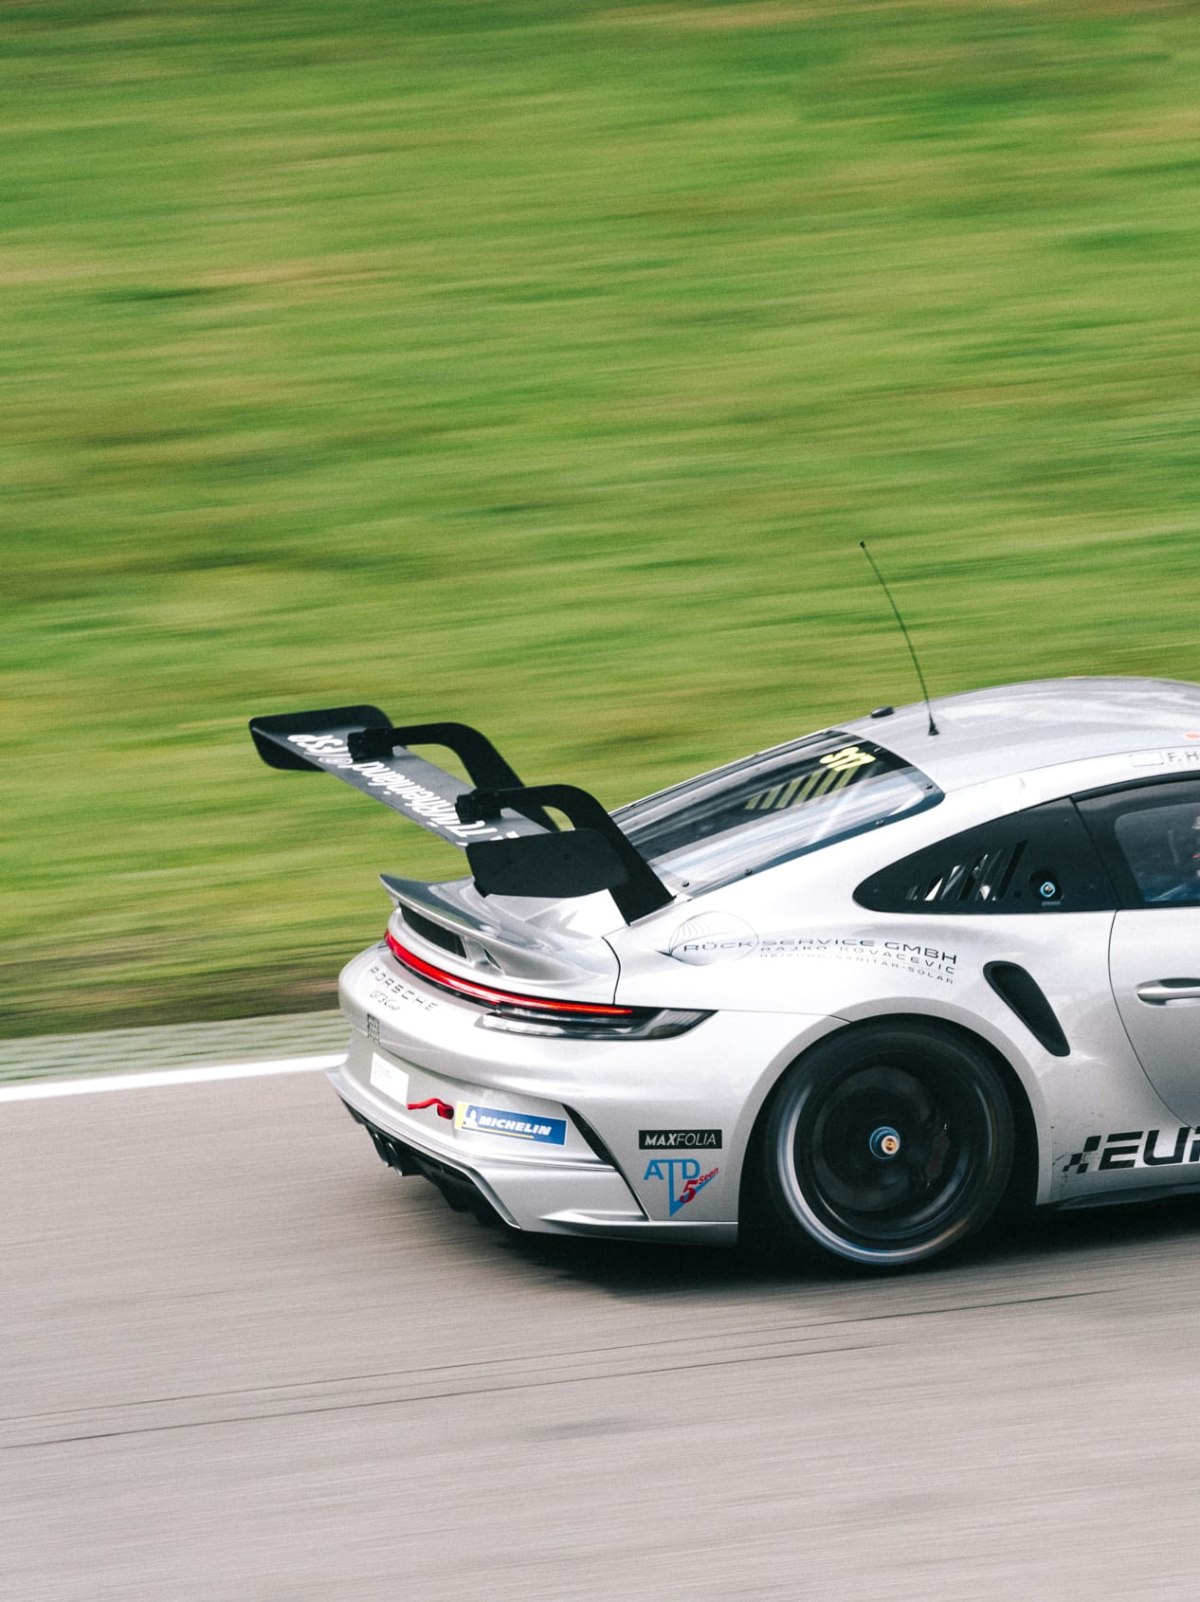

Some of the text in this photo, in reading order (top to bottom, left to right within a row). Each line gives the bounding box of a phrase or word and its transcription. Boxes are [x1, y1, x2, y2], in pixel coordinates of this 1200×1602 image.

[1167, 752, 1183, 762] F.
[761, 938, 876, 947] SERVICE
[884, 941, 957, 964] GMBH
[840, 946, 955, 975] KOVACEVIC
[370, 966, 440, 1011] PORSCHE
[479, 1116, 552, 1136] MICHELIN
[644, 1133, 718, 1147] MAXFOLIA
